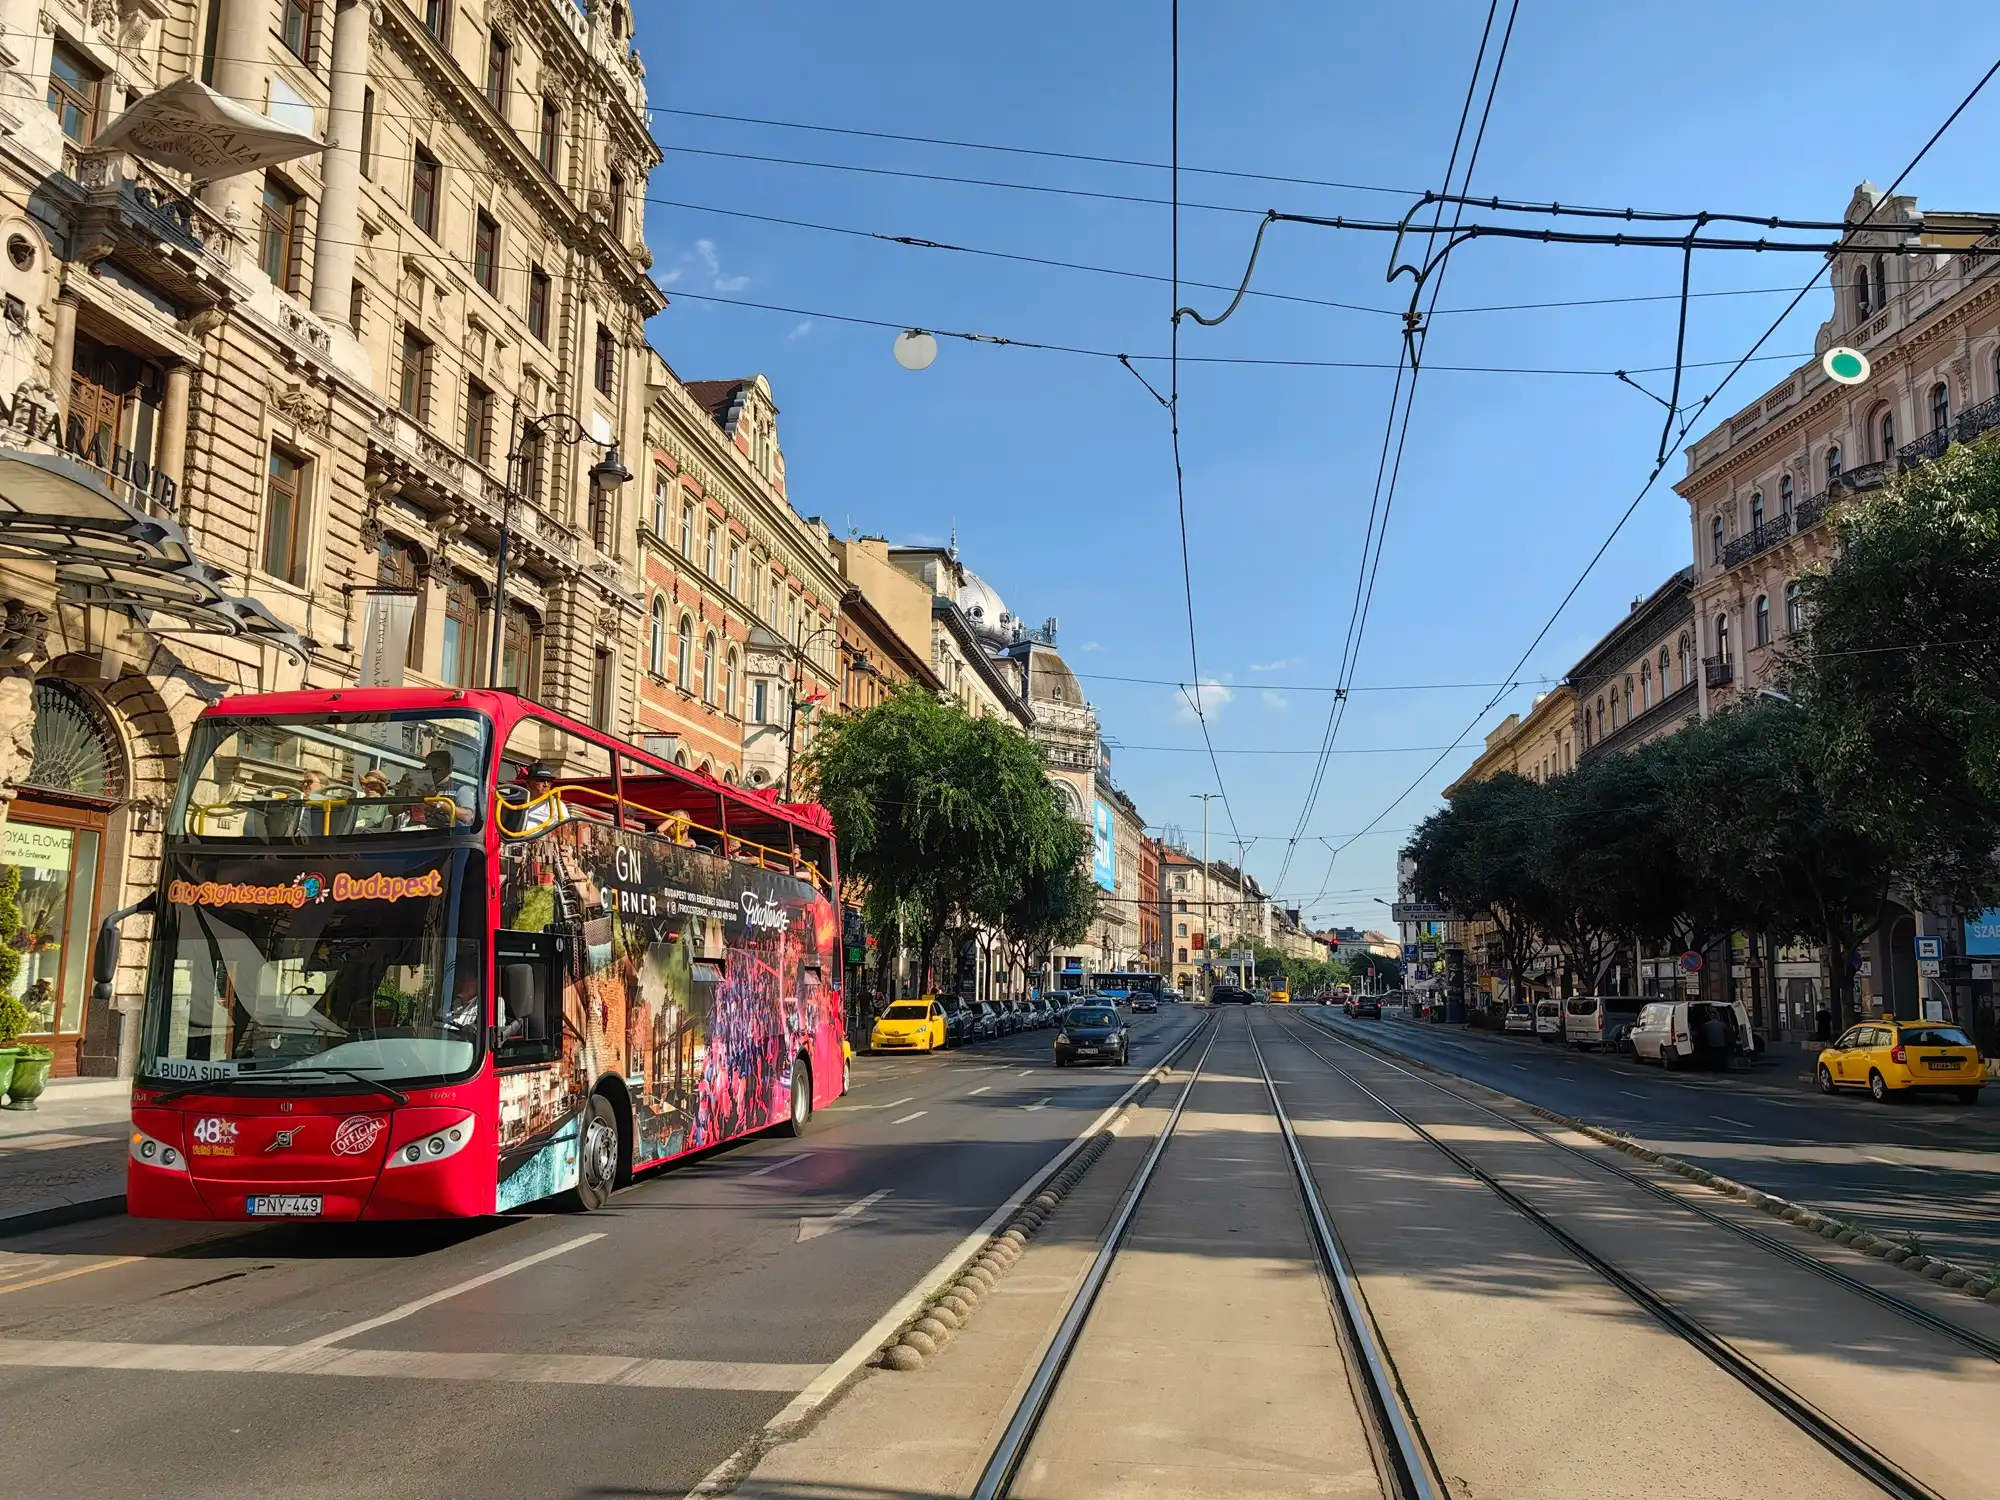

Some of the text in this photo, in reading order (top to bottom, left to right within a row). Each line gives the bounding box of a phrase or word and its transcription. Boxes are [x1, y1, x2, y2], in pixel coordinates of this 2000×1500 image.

[110, 444, 179, 514] HOTEL
[377, 607, 389, 645] PALACE
[373, 650, 383, 678] YORK
[333, 869, 442, 902] Budapest
[664, 887, 687, 901] BUDAPEST
[600, 886, 657, 916] CORNER
[161, 1063, 231, 1081] BUDA SIDE
[193, 1117, 221, 1144] 48
[336, 1119, 384, 1152] OFFICIAL
[354, 1135, 375, 1151] TOUR
[256, 1198, 318, 1212] PNY-449
